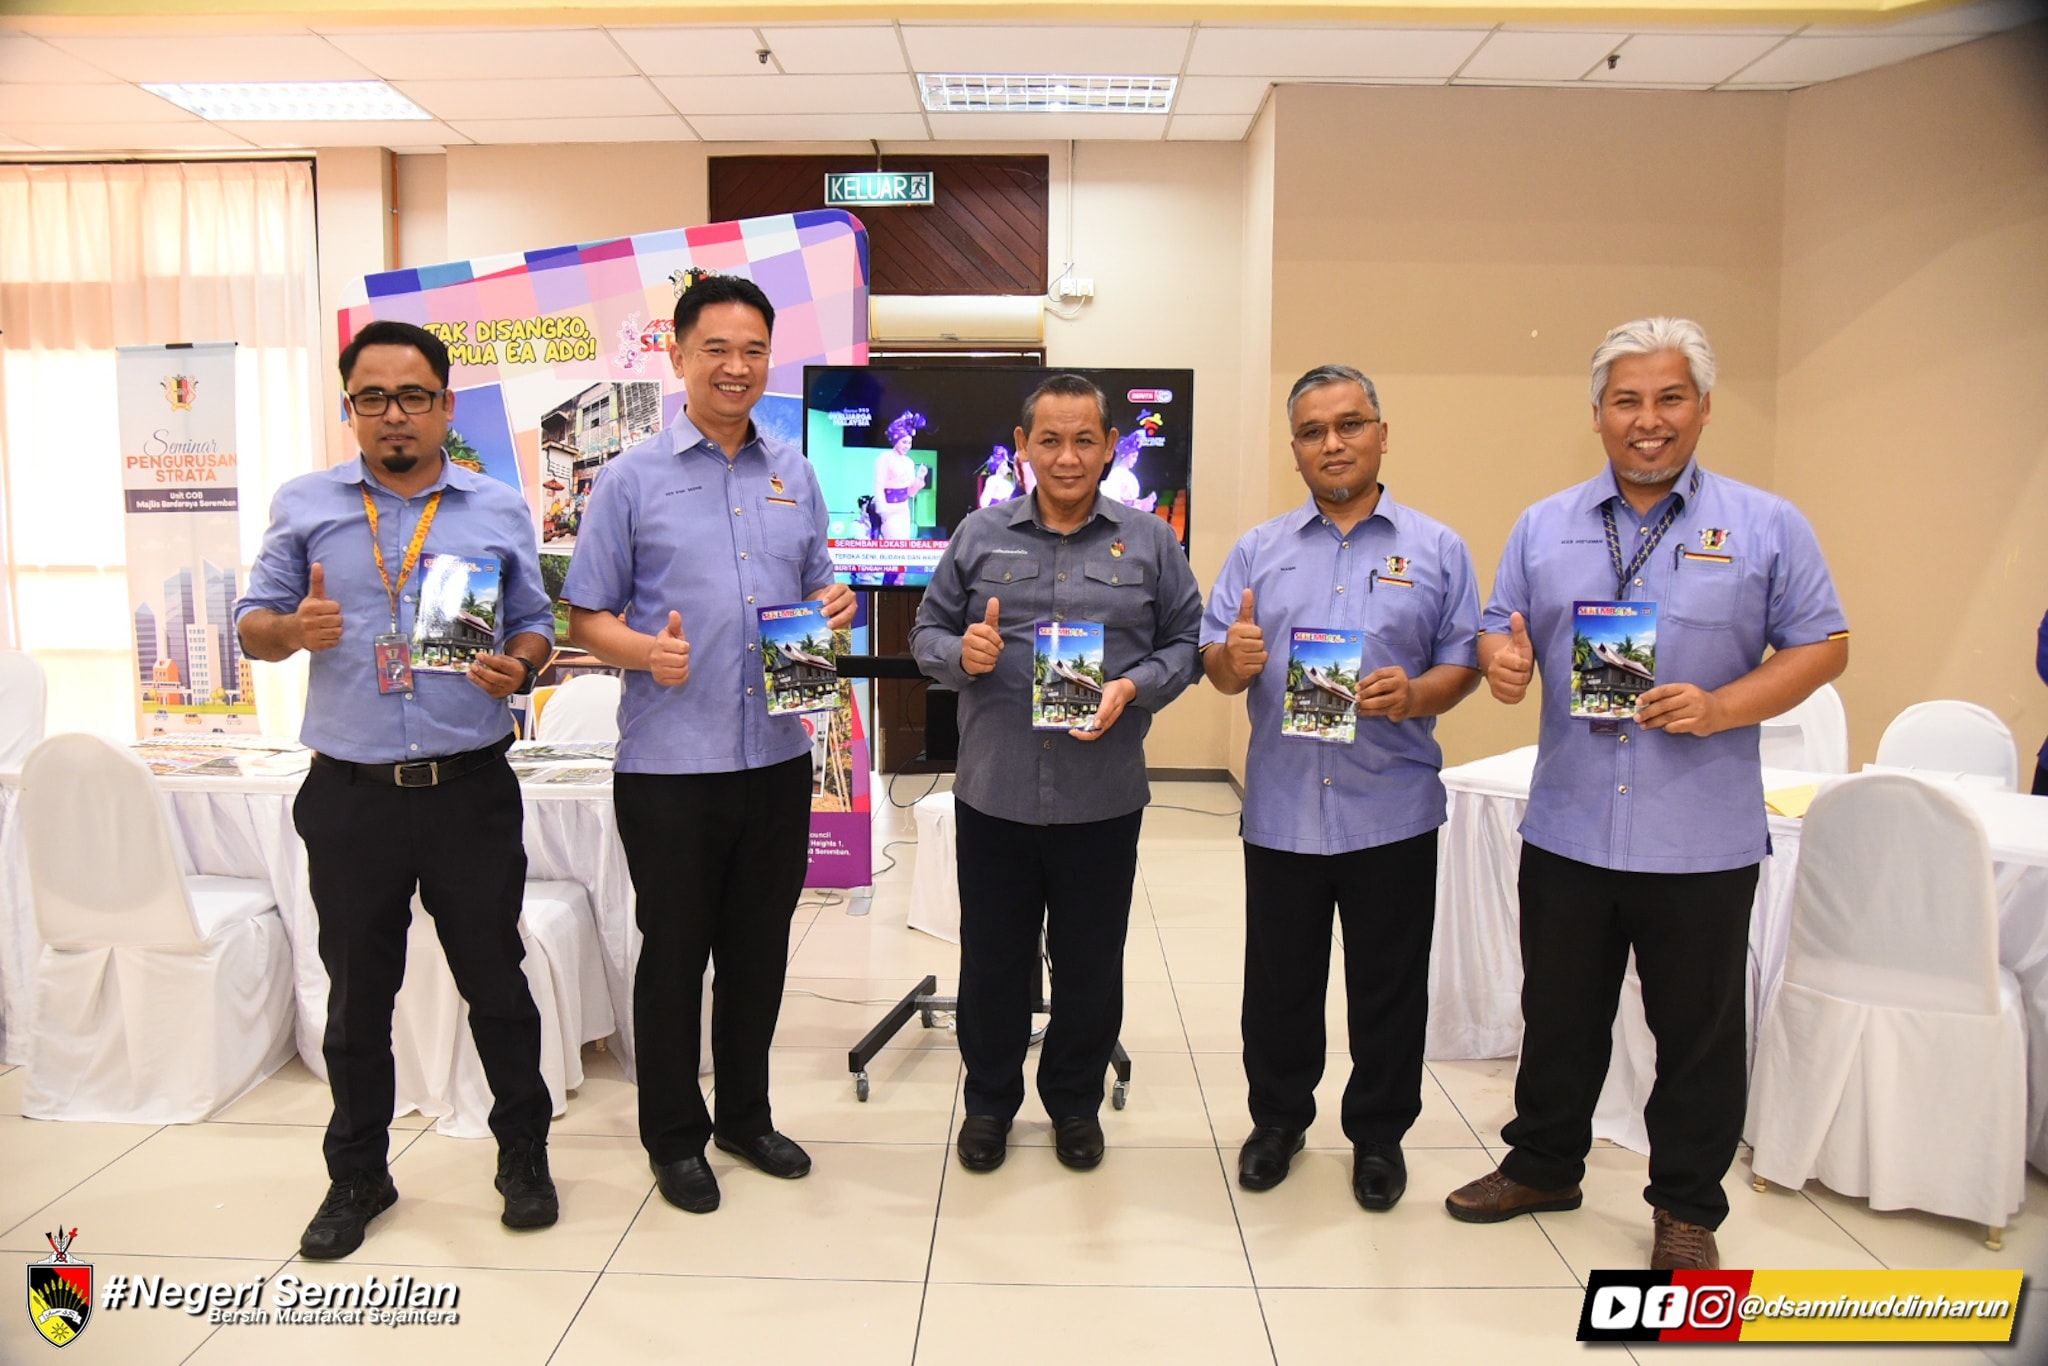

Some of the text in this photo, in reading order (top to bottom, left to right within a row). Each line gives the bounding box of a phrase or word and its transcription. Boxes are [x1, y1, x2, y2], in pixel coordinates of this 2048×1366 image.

[832, 176, 908, 200] KELUAR
[422, 316, 591, 343] TAK DISANGKO,
[446, 337, 597, 366] MUA EA ADO!
[144, 428, 218, 457] Seminar
[127, 453, 237, 469] PENGURUSAN
[156, 468, 217, 483] STRATA
[186, 491, 203, 500] COB
[136, 498, 237, 510] Majlis Bandaraya Seremban
[834, 540, 878, 548] SEREMBAN
[879, 540, 907, 548] LOKASI
[909, 540, 932, 549] IDEAL
[811, 840, 836, 848] Heights
